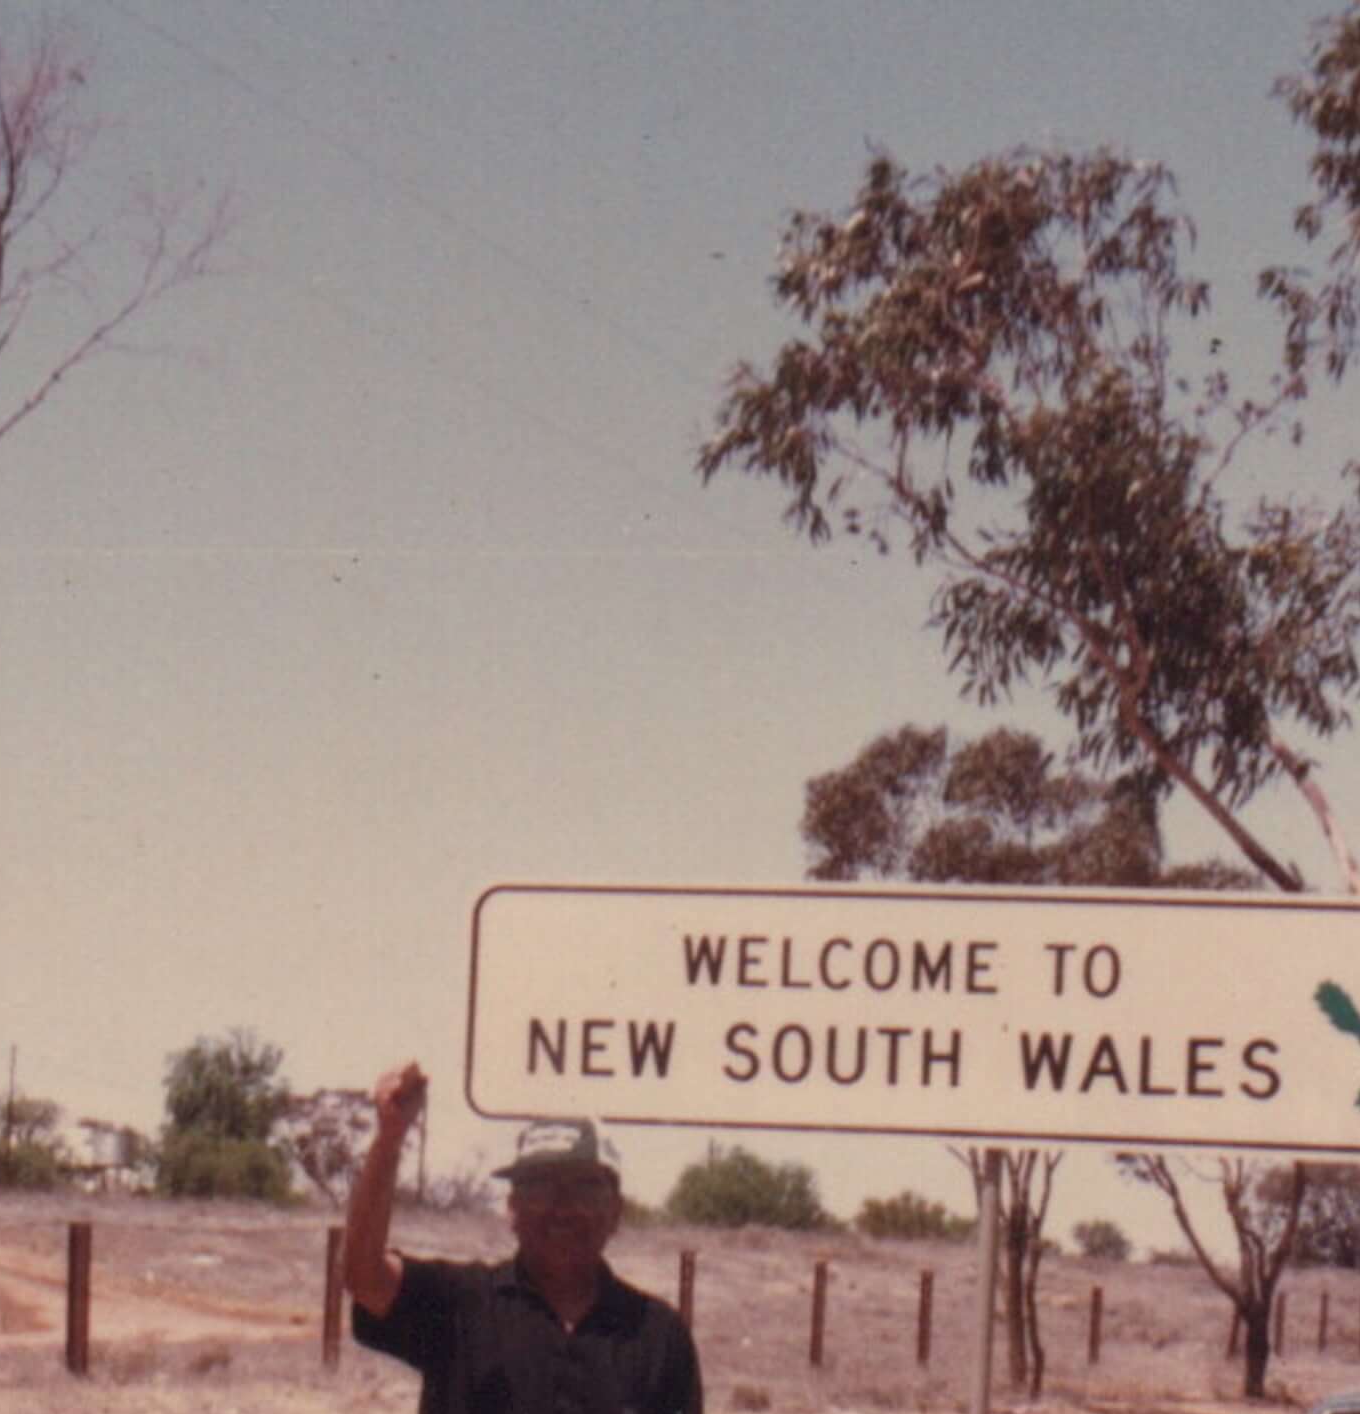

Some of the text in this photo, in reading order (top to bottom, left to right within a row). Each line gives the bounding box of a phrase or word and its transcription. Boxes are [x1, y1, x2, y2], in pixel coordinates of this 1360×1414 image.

[682, 933, 1123, 1000] WELCOME TO
[525, 1017, 1284, 1102] NEW SOUTH WALES
